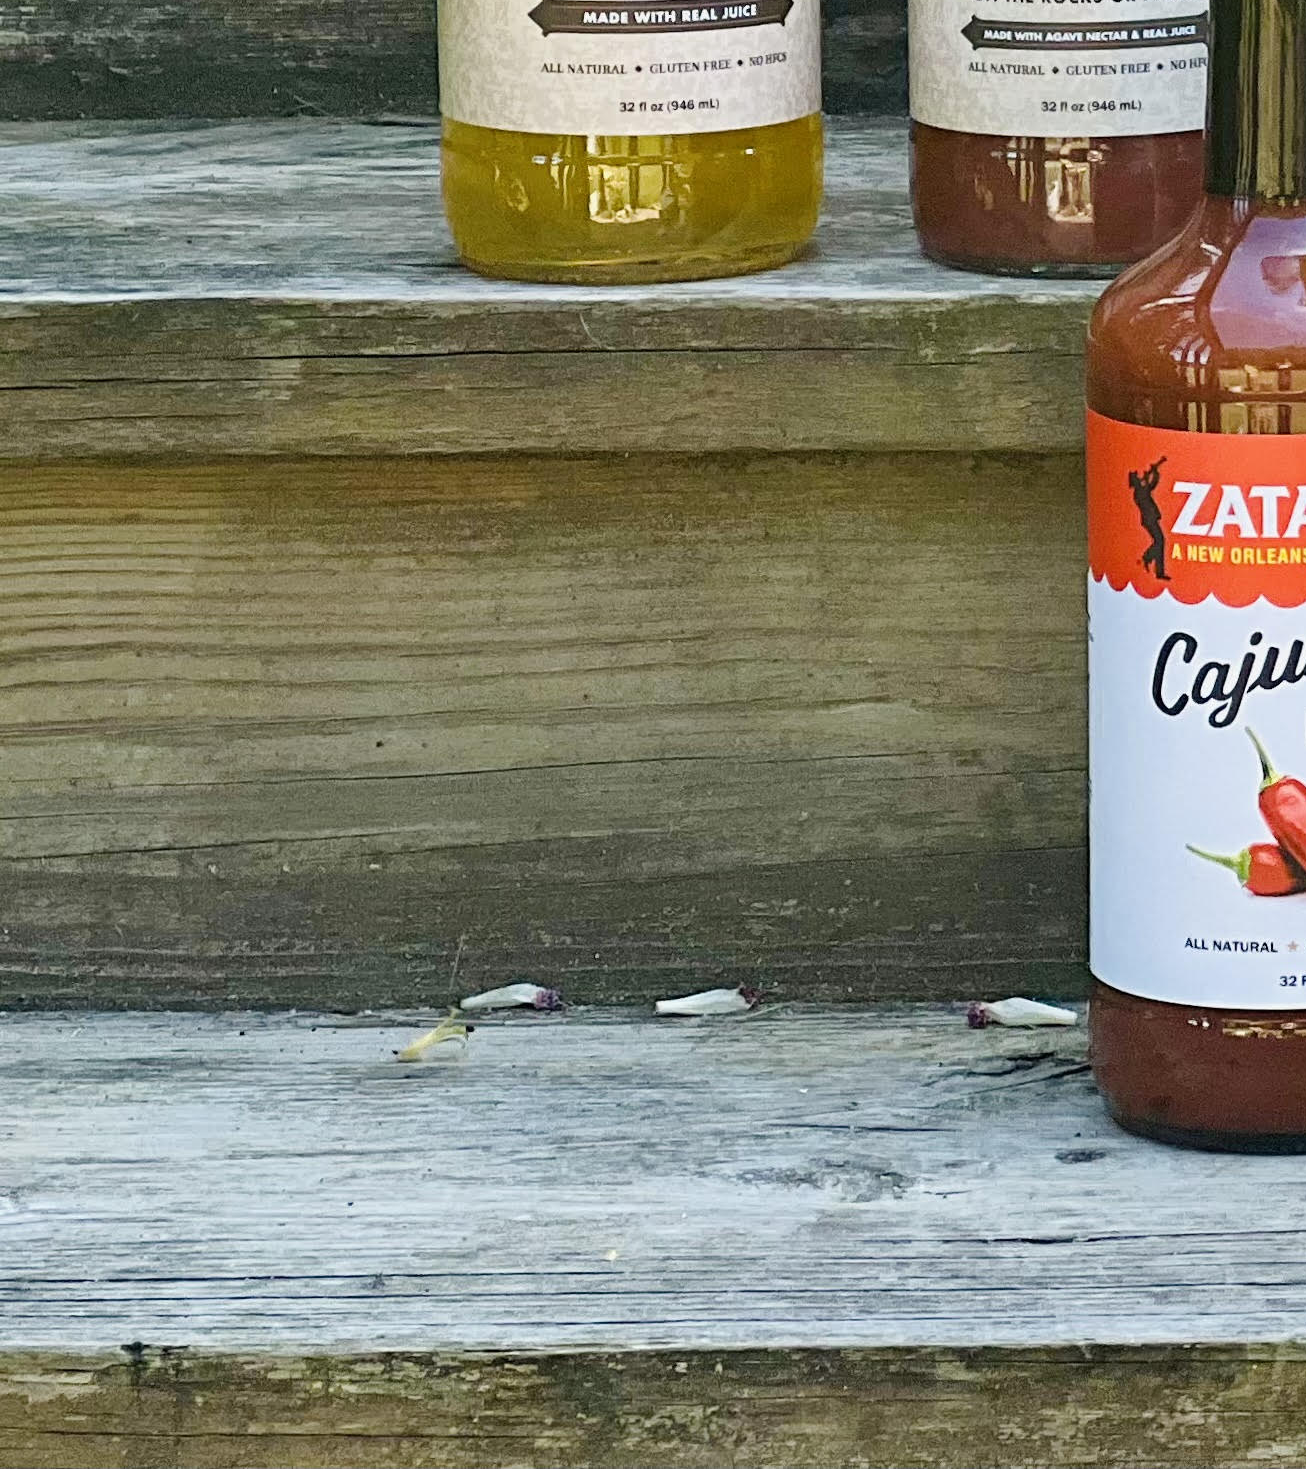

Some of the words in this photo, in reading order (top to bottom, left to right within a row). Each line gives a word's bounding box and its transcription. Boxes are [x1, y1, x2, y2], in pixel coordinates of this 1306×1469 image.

[583, 12, 628, 24] MADE
[634, 10, 676, 23] WITH
[682, 7, 718, 21] REAL
[722, 4, 757, 18] JUICE
[1172, 543, 1182, 559] A
[1187, 545, 1223, 563] NEW
[1185, 937, 1208, 950] ALL
[1213, 940, 1278, 953] NATURAL
[1279, 976, 1297, 987] 32
